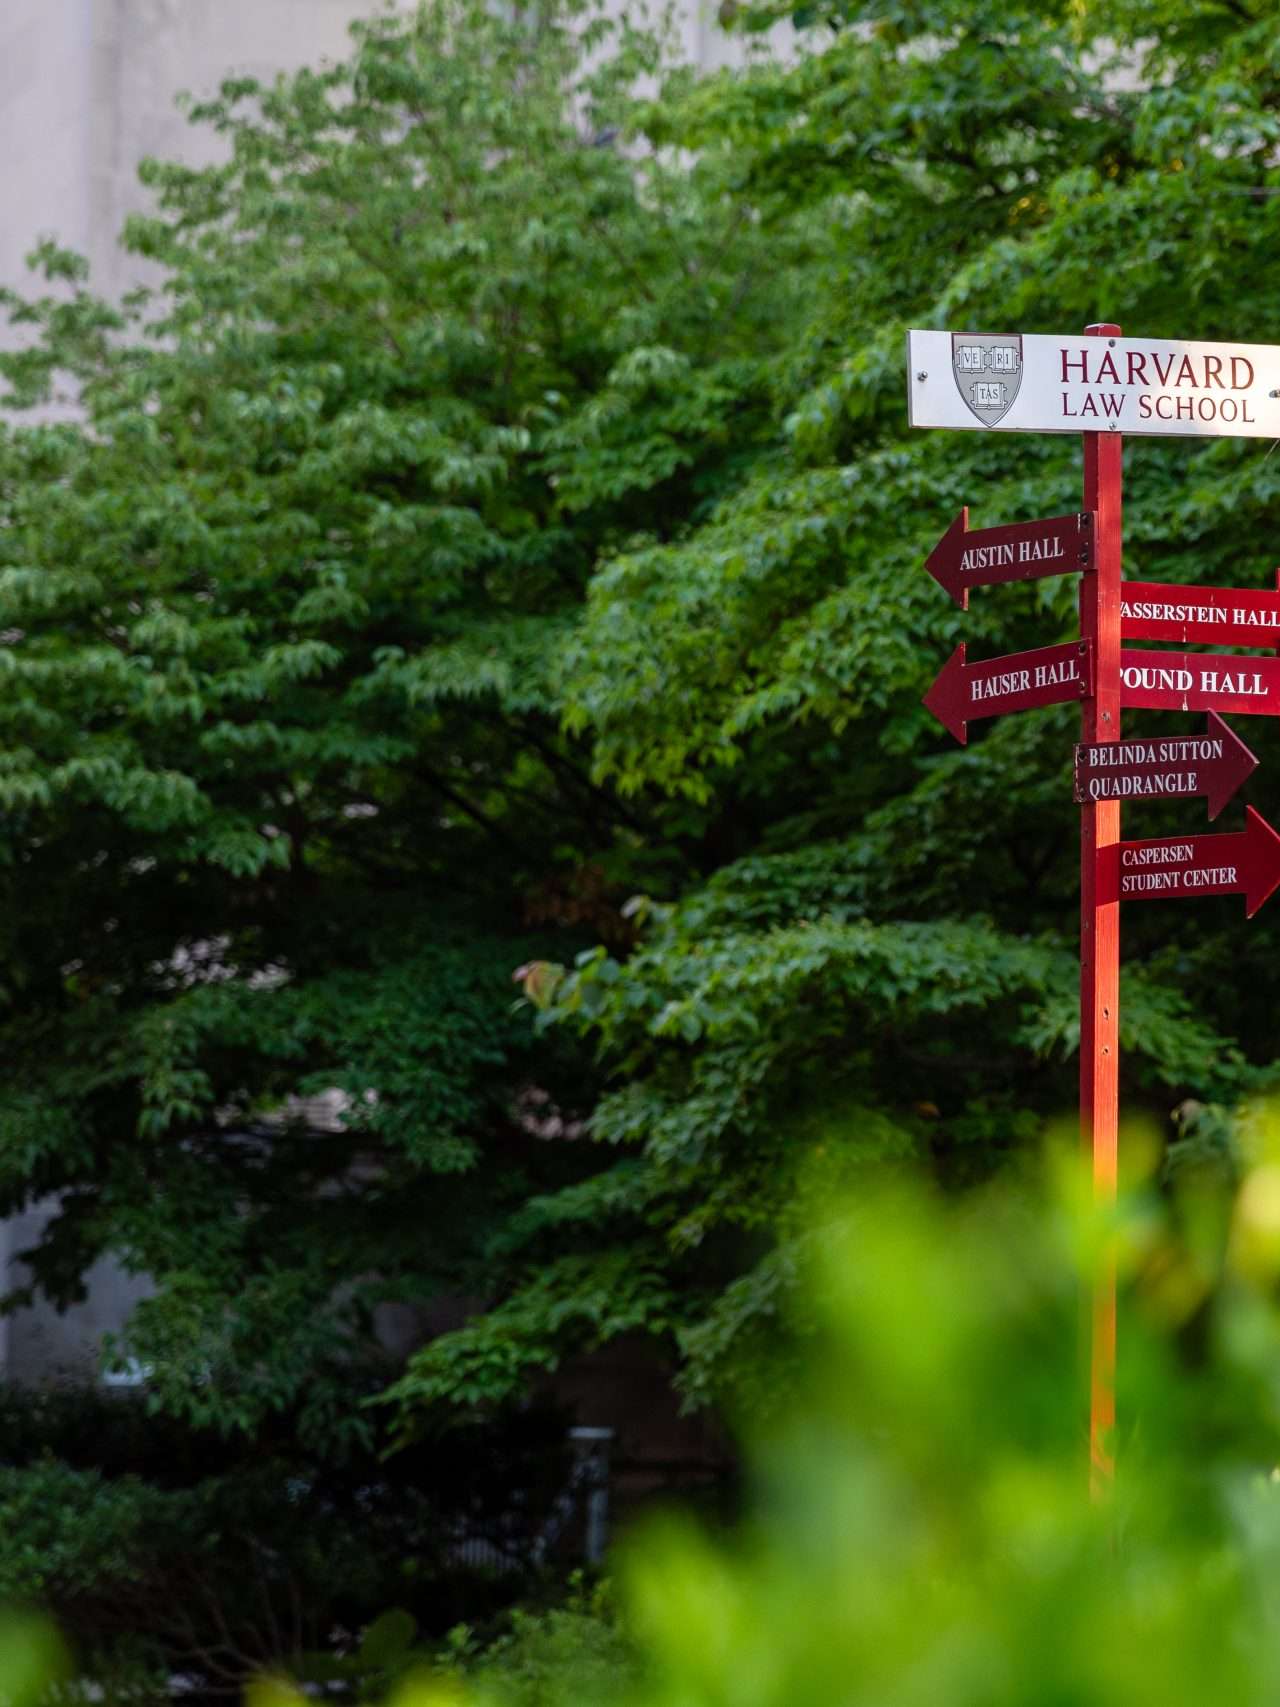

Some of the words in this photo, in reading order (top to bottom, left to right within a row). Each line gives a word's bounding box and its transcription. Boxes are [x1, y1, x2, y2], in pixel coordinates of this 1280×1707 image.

[964, 353, 979, 364] VE
[1060, 349, 1255, 390] HARVARD
[979, 388, 999, 400] TAS
[1062, 392, 1126, 417] LAW
[1139, 394, 1255, 423] SCHOOL
[960, 543, 1015, 571] AUSTIN
[1019, 536, 1064, 562] HALL
[1120, 601, 1227, 624] ASSERSTEIN
[971, 670, 1031, 701] HAUSER
[1034, 659, 1080, 688] HALL
[1120, 667, 1193, 691] OUND
[1200, 671, 1269, 695] HALL
[1089, 745, 1157, 767] BELINDA
[1159, 739, 1223, 763] SUTTON
[1089, 772, 1197, 800] QUADRANGLE
[1122, 844, 1194, 866] CASPERSEN
[1122, 871, 1180, 892] STUDENT
[1183, 867, 1238, 887] CENTER
